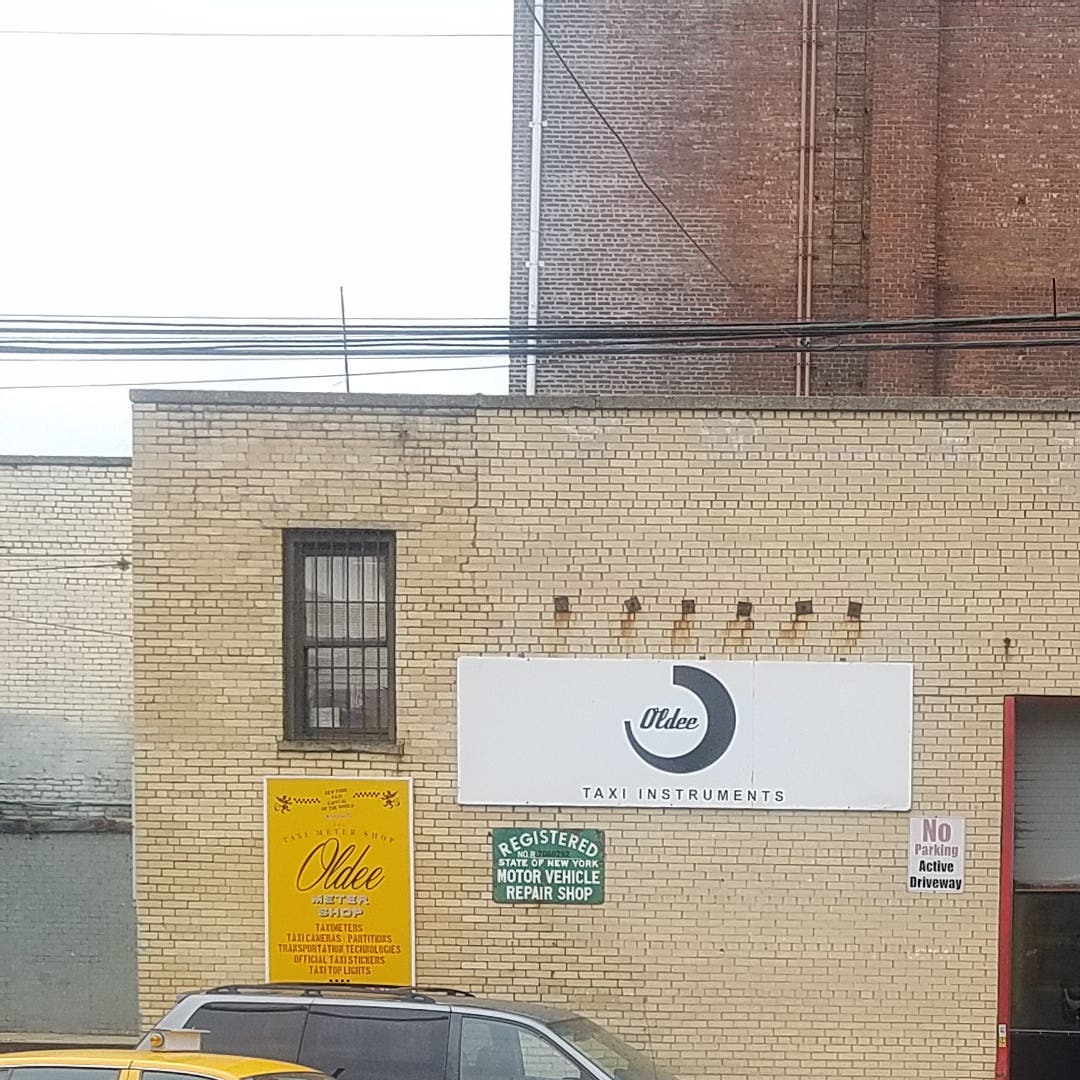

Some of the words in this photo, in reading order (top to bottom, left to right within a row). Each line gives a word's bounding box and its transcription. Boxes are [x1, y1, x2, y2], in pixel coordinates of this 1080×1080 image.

[640, 707, 699, 730] Oldee
[583, 787, 626, 799] TAXI
[639, 789, 784, 802] INSTRUMENTS
[923, 819, 951, 842] No
[364, 831, 395, 843] SHOP
[498, 830, 599, 857] REGISTERED
[914, 844, 959, 858] Parking
[297, 838, 385, 892] Oldee
[499, 859, 528, 867] STATE
[531, 859, 544, 867] OF
[547, 859, 569, 867] NEW
[573, 860, 599, 868] YORK
[919, 860, 954, 872] Active
[497, 869, 541, 883] MOTOR
[545, 869, 601, 884] VEHICLE
[910, 876, 962, 890] Driveway
[506, 886, 553, 900] REPAIR
[557, 887, 593, 901] SHOP
[312, 895, 370, 905] METER
[319, 908, 364, 918] SHOP
[316, 923, 363, 932] TAXIMETERS
[287, 933, 304, 942] TAXI
[306, 933, 341, 942] CAMERAS
[348, 934, 392, 943] PARTITIONS
[278, 944, 343, 953] TRANSPORTATION
[346, 945, 401, 954] TECHNOLOGIES
[294, 955, 327, 963] OFFICIAL
[329, 956, 347, 964] TAXI
[348, 956, 385, 964] STICKERS
[309, 966, 327, 974] TAXI
[328, 966, 342, 974] TOP
[343, 966, 371, 975] LIGHTS
